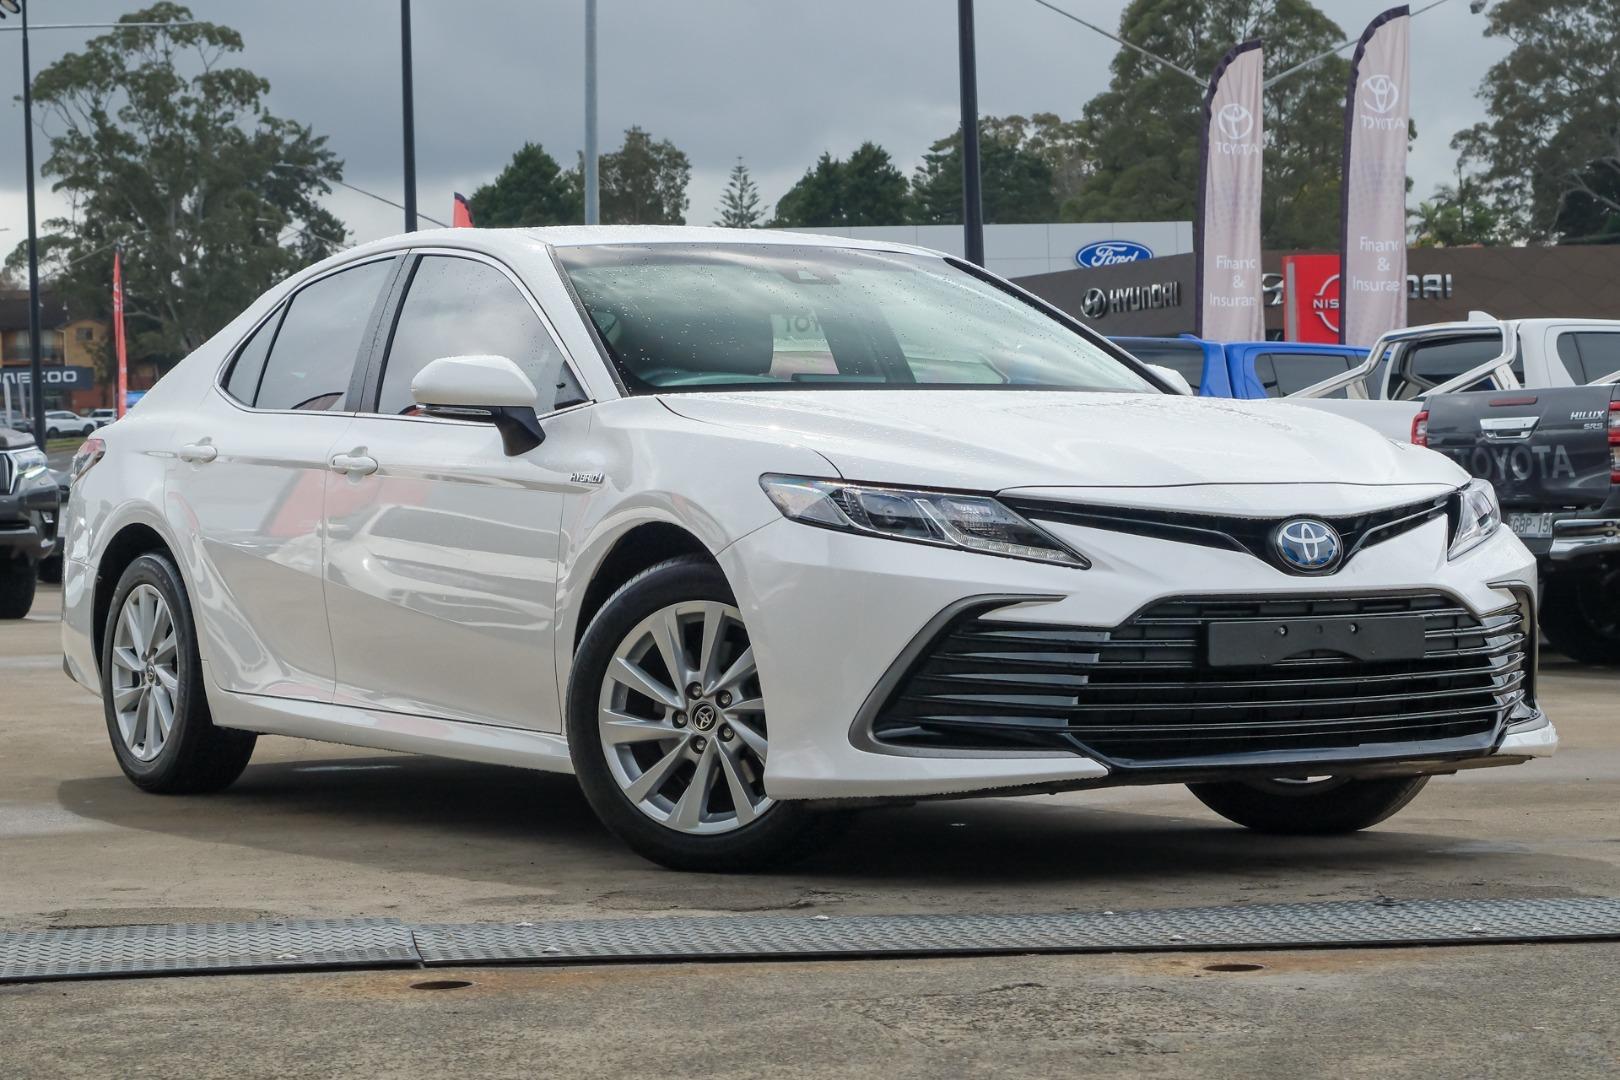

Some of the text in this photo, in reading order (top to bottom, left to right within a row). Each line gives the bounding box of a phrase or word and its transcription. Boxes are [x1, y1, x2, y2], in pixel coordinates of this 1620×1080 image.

[1091, 245, 1139, 267] Ford
[1216, 255, 1257, 270] Financ
[1377, 256, 1392, 272] &
[1232, 272, 1245, 289] &
[1108, 281, 1181, 313] HYUNDAI
[1209, 291, 1257, 307] Insuran
[1313, 299, 1340, 309] NIS
[1570, 410, 1605, 420] HILUX
[1454, 445, 1576, 480] TOYOTA
[569, 472, 605, 484] HYBRID
